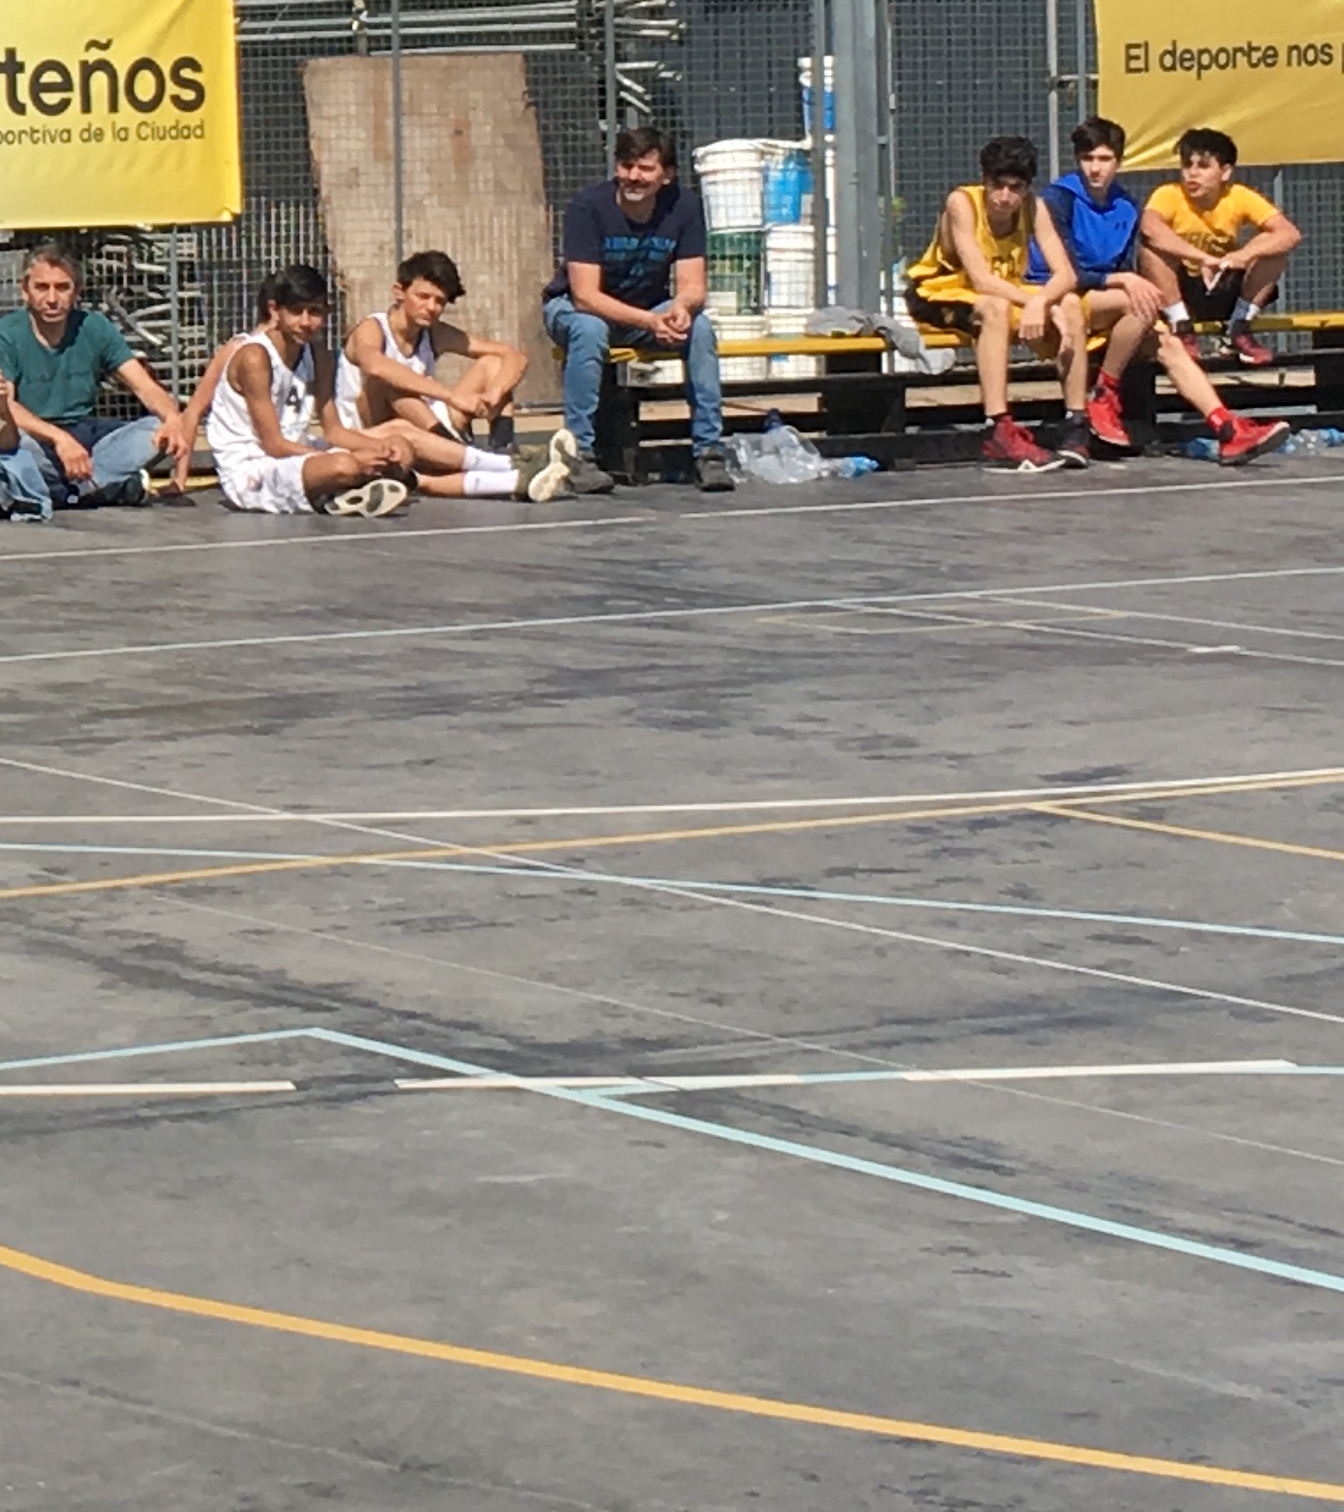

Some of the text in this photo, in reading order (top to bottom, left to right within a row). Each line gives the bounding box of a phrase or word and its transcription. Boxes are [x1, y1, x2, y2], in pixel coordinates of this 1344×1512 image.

[1124, 40, 1149, 74] El
[1159, 39, 1279, 81] deporte
[1286, 42, 1334, 68] nos
[79, 121, 105, 143] de
[111, 121, 129, 142] la
[135, 119, 205, 142] Ciudad
